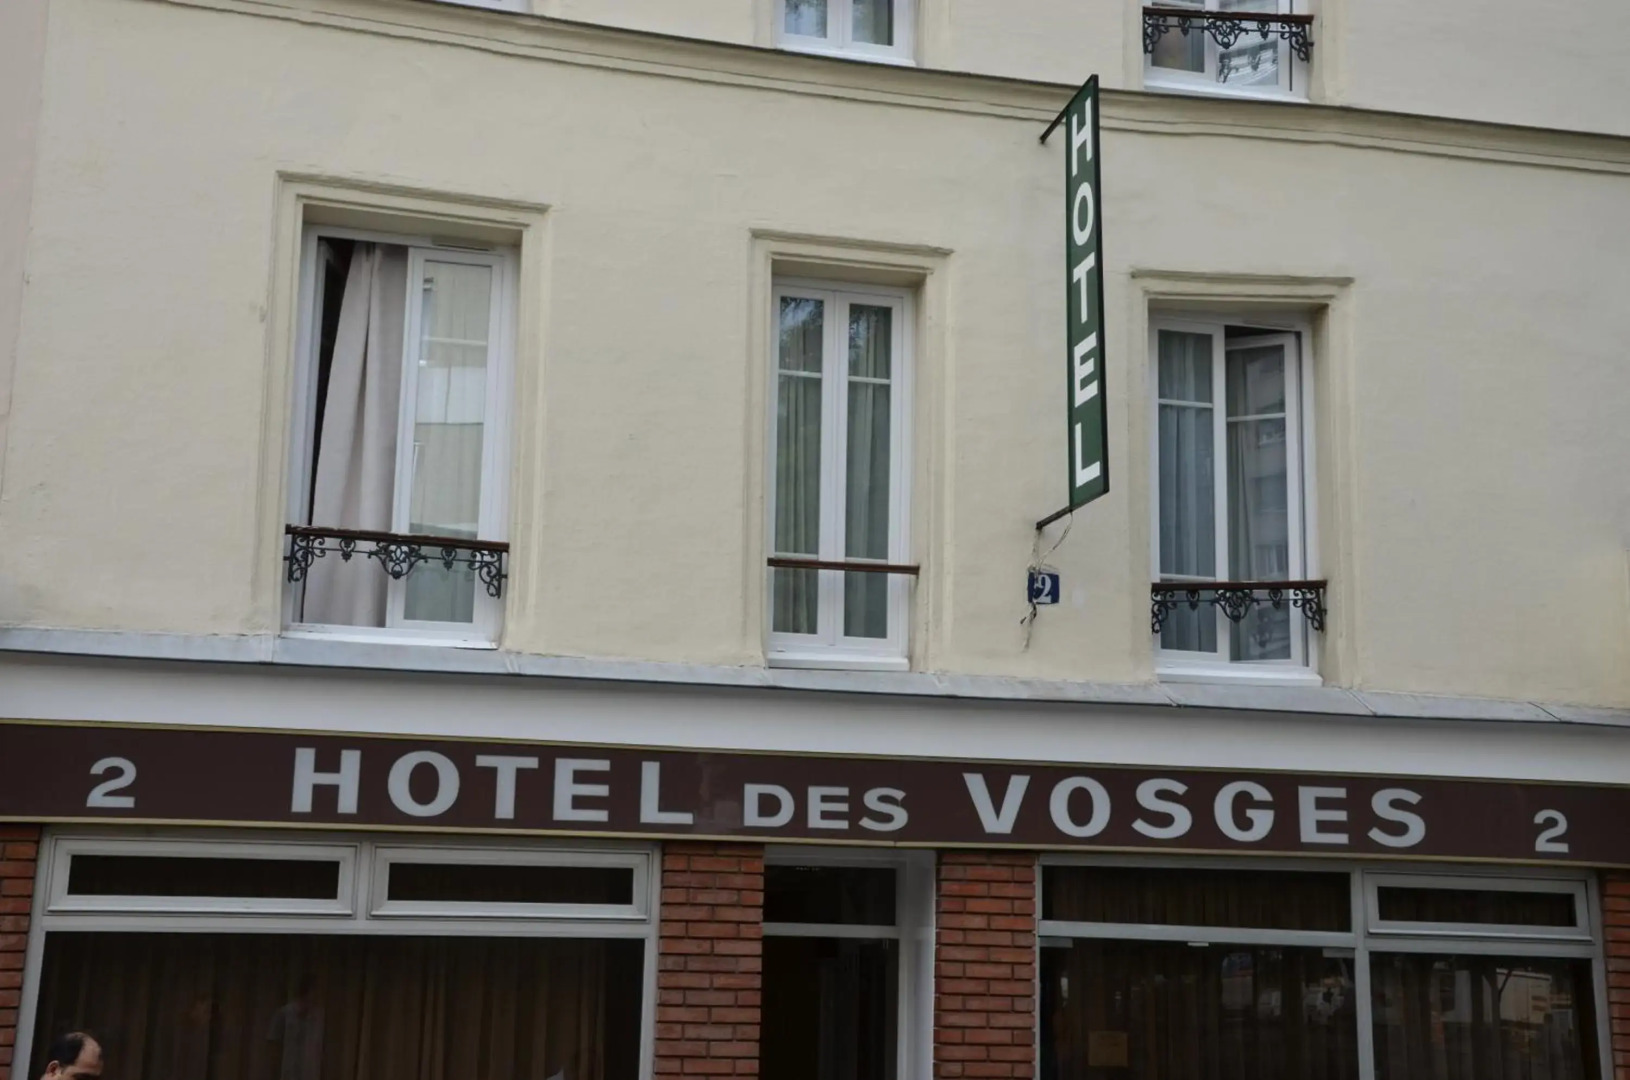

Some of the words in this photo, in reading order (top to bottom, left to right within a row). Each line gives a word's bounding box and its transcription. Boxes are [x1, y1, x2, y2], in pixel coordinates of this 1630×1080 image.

[1071, 96, 1102, 488] HOTEL
[1033, 574, 1052, 603] 2
[85, 757, 137, 808] 2
[290, 747, 694, 826] HOTEL
[743, 783, 909, 831] DES
[962, 772, 1426, 847] VOSGES
[1533, 809, 1570, 854] 2
